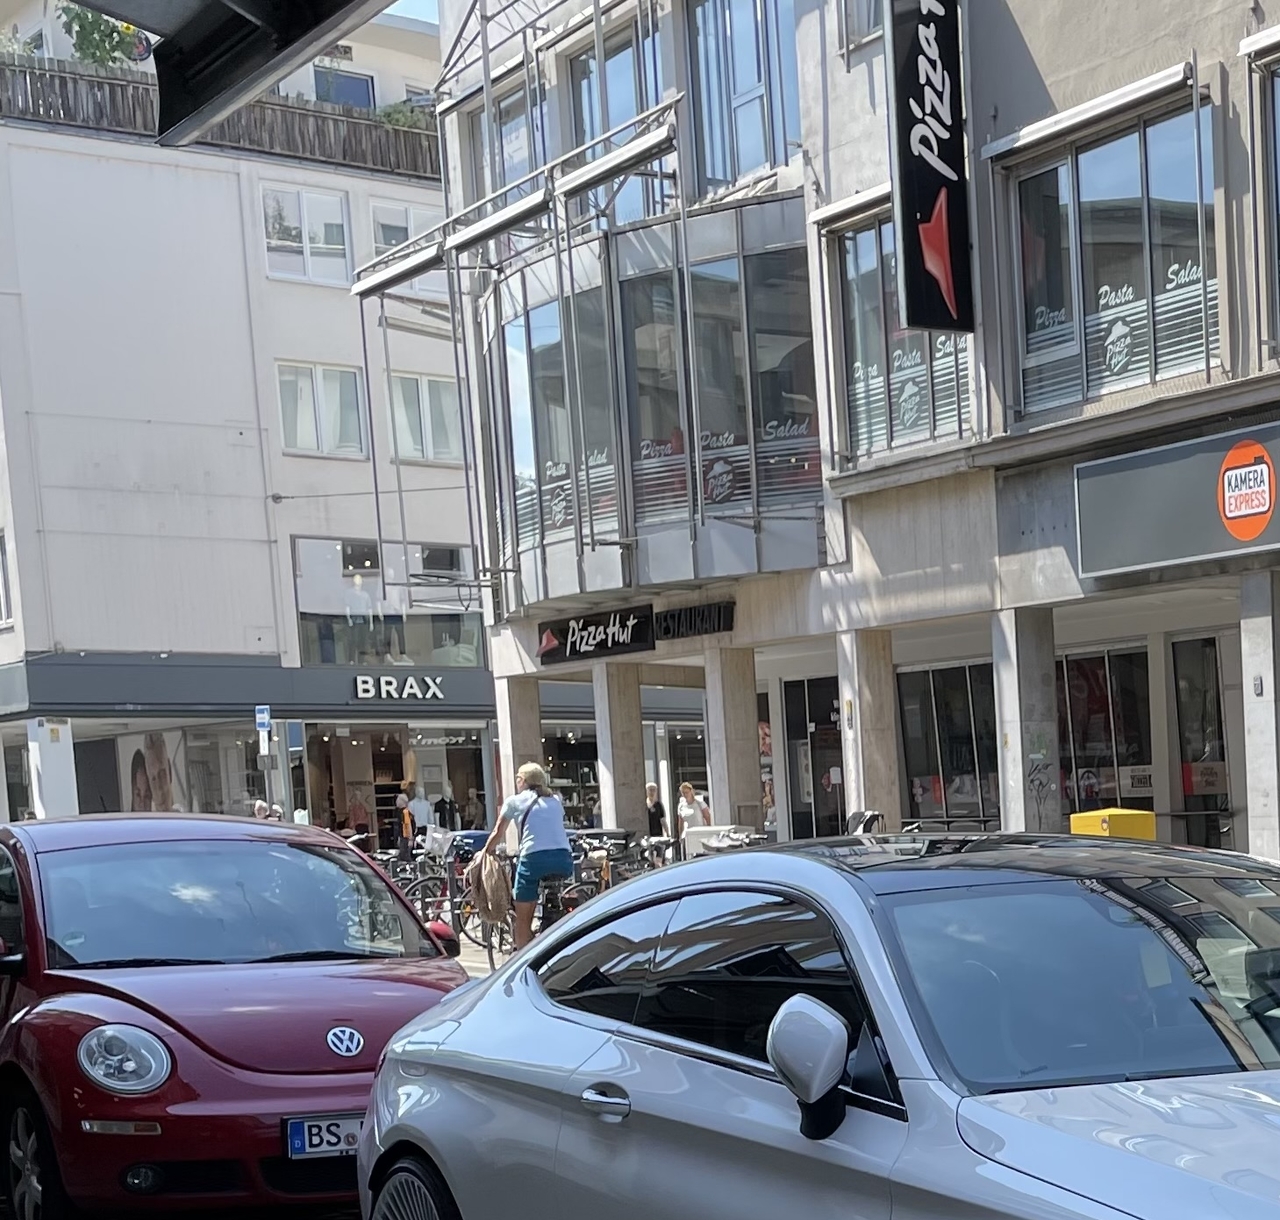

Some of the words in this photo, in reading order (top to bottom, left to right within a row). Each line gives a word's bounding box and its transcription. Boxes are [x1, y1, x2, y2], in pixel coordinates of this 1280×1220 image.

[910, 22, 958, 181] Pizza
[1098, 284, 1135, 312] Pasta
[1035, 306, 1067, 330] Pizza
[893, 348, 922, 372] Pasta
[1106, 336, 1132, 366] Pizza
[1110, 348, 1129, 369] Hut
[700, 430, 735, 447] Pasta
[765, 417, 810, 441] Salad
[639, 440, 672, 461] Pizza
[708, 472, 733, 493] Pizza
[1226, 468, 1266, 495] KAMERA
[1227, 488, 1267, 514] EXPRESS
[655, 604, 727, 640] RESTAURANT
[566, 619, 606, 657] Pizza
[607, 613, 639, 648] Hut
[355, 675, 445, 700] BRAX
[307, 1122, 342, 1149] BS
